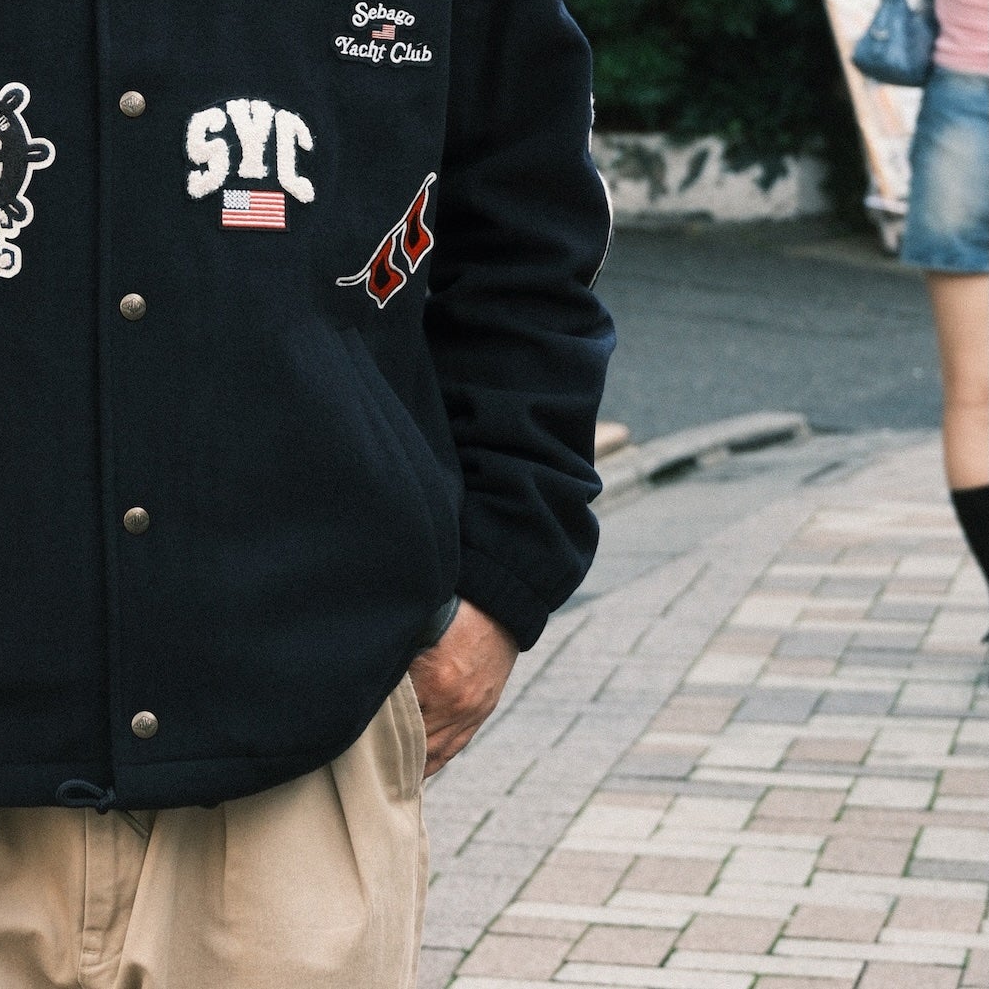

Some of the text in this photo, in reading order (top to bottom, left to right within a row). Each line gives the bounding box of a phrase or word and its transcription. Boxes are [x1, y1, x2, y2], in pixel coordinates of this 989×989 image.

[352, 1, 415, 28] Sebago
[335, 35, 433, 63] Yacht Club
[186, 98, 316, 204] SYC
